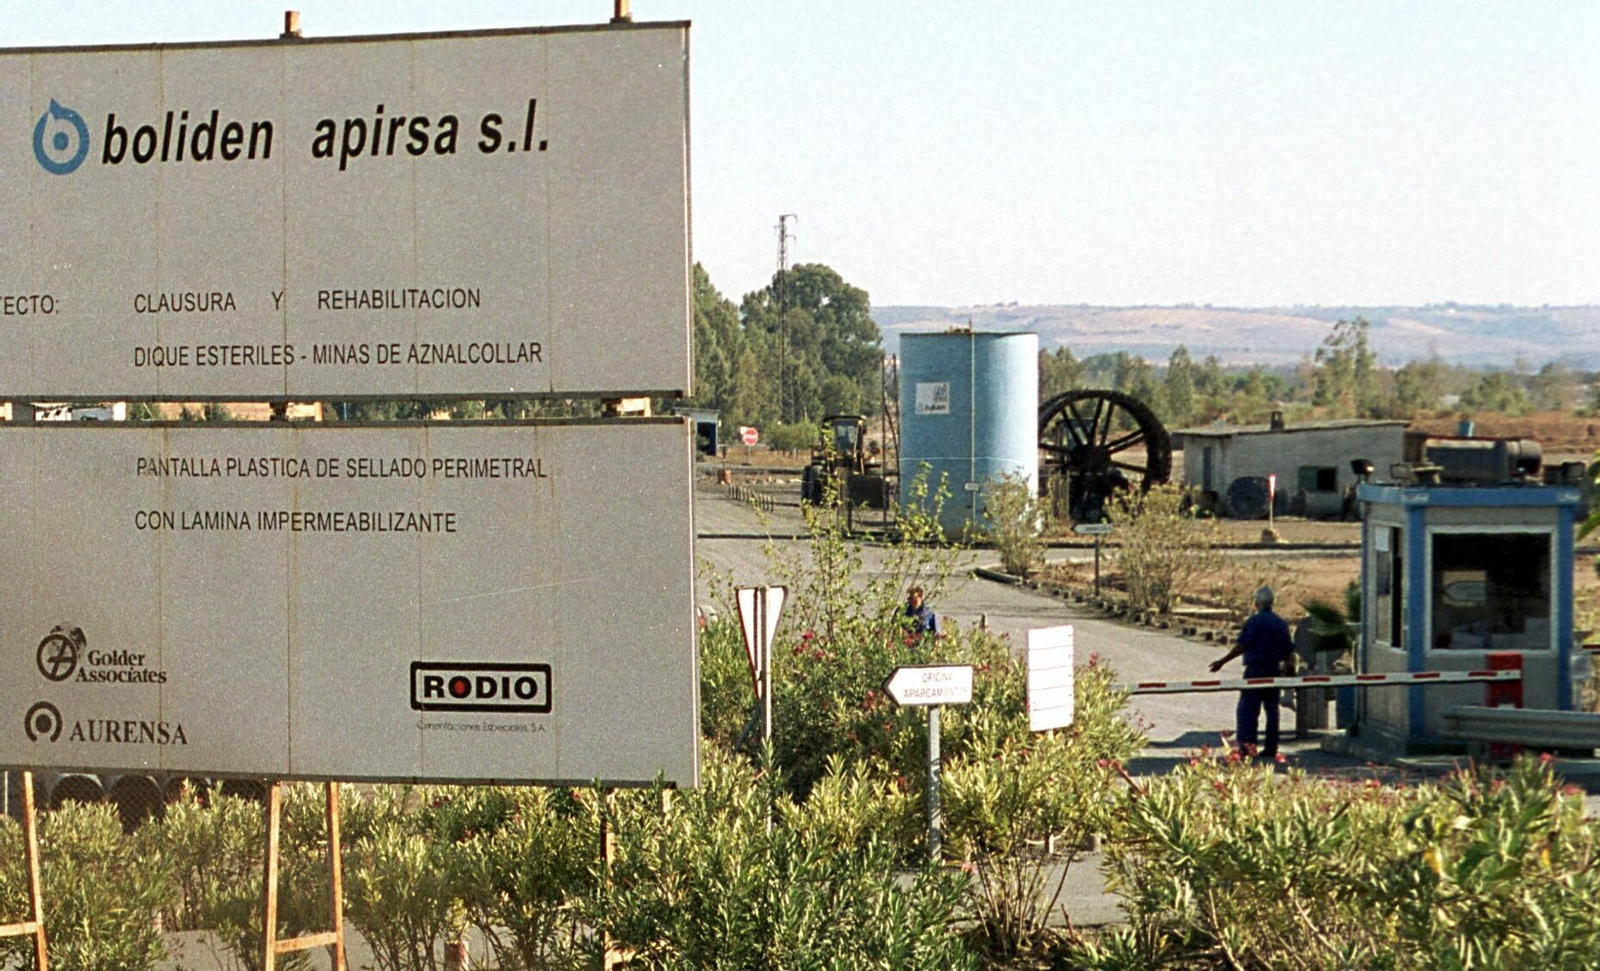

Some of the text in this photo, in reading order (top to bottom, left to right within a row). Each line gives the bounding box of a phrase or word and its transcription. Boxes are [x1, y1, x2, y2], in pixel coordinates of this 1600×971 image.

[101, 97, 549, 172] boliden apirsa s.l.
[0, 288, 481, 316] ECTO: CLAUSURA Y REHABILITACION
[134, 345, 190, 368] DIQUE
[195, 344, 296, 367] ESTERILES
[312, 342, 371, 366] MINAS
[376, 342, 401, 366] DE
[406, 341, 543, 366] AZNALCOLLAR
[136, 457, 548, 480] PANTALLA PLASTICA DE SELLADO PERIMETRAL
[134, 510, 457, 533] CON LAMINA IMPERMEABILIZANTE
[87, 650, 146, 667] Golder
[75, 666, 168, 684] Associates
[423, 675, 539, 700] RODIO
[69, 719, 189, 746] AURENSA
